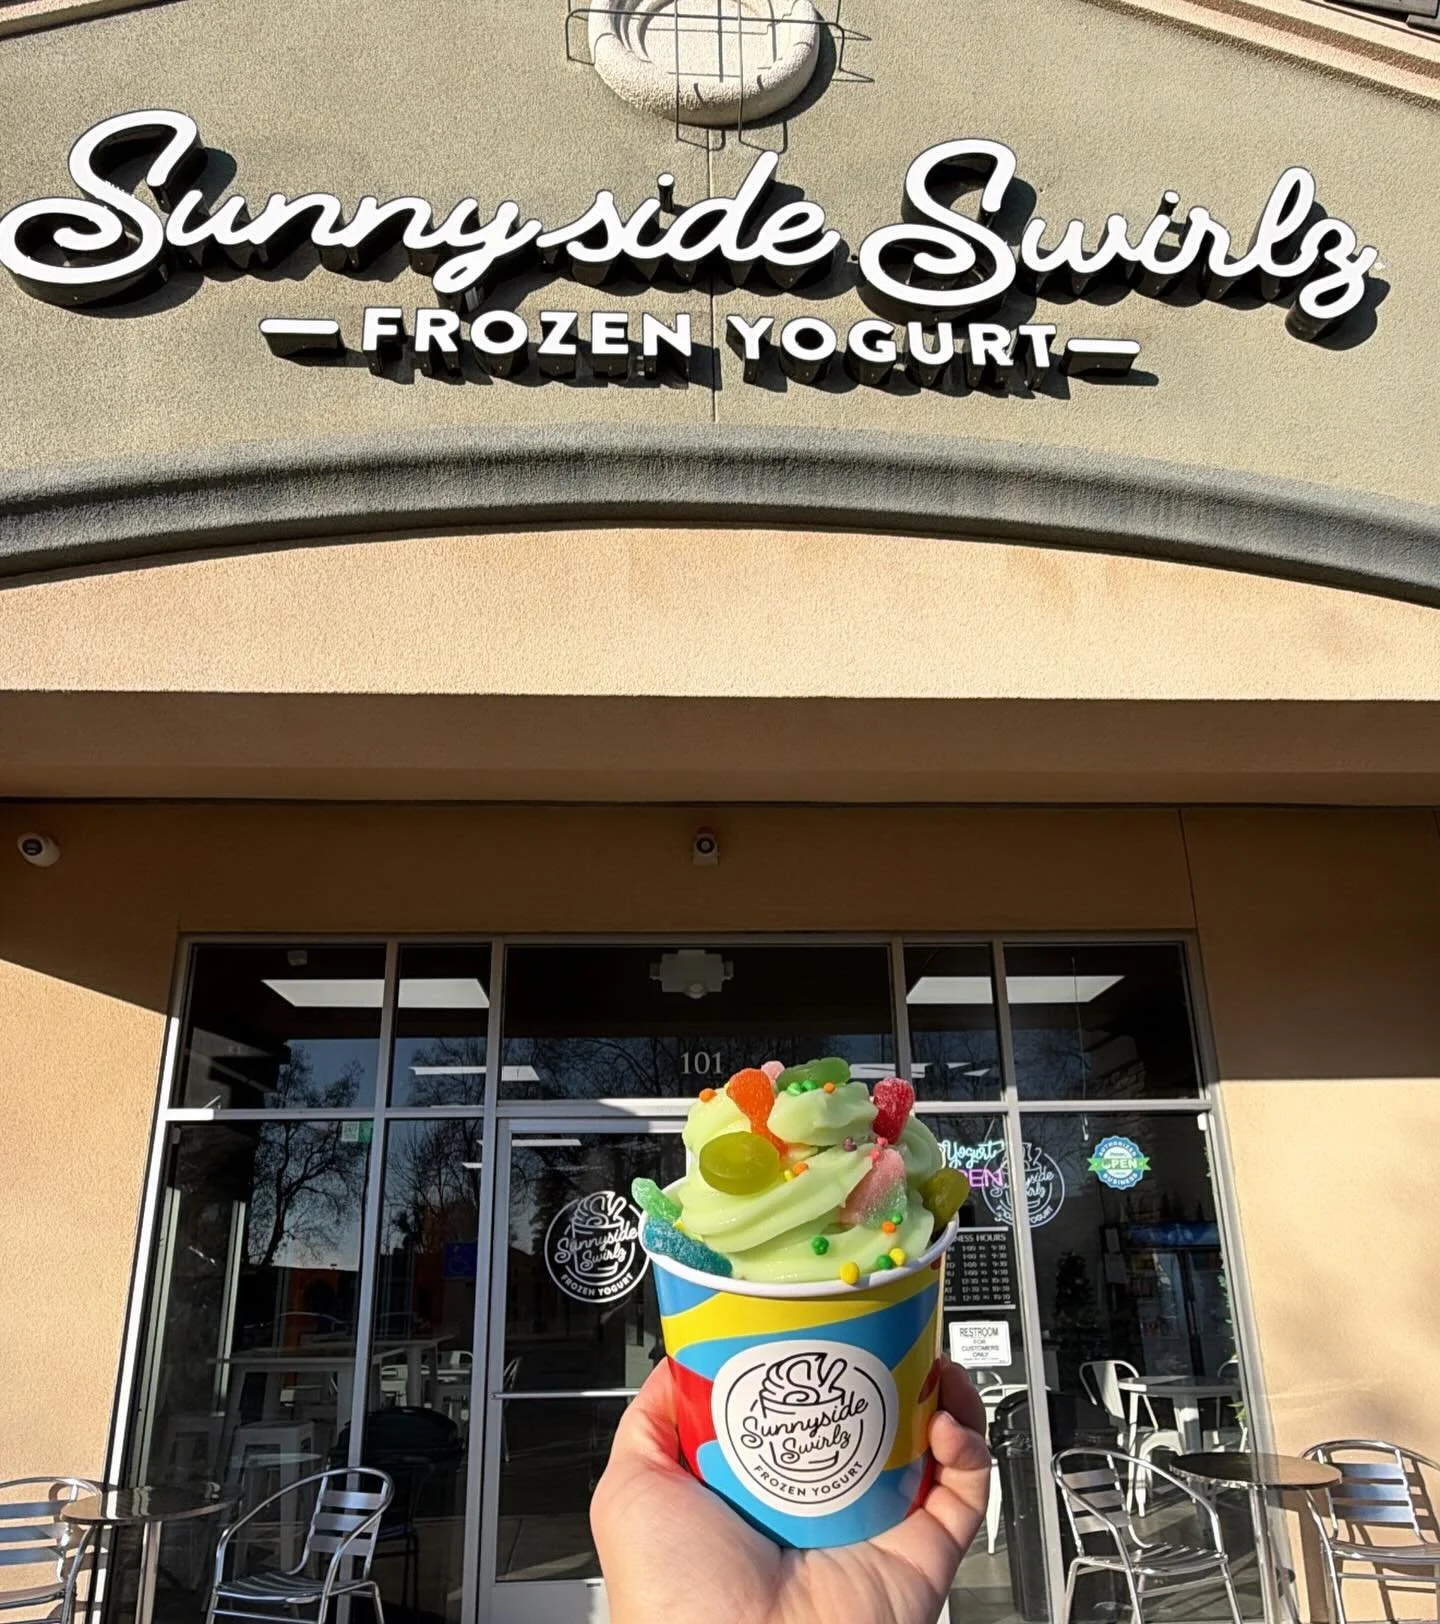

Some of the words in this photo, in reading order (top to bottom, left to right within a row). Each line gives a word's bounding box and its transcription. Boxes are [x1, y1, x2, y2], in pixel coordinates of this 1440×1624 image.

[0, 109, 841, 293] Sunnyside
[858, 137, 1379, 319] Swirlz
[361, 307, 692, 357] FROZEN
[727, 316, 1057, 368] YOGURT
[680, 1051, 723, 1075] 101
[960, 1168, 1005, 1188] EN
[1101, 1158, 1138, 1169] OPEN
[554, 1220, 638, 1264] Sunnyside
[579, 1241, 628, 1271] Swirlz
[560, 1274, 596, 1297] FROZEN
[597, 1271, 635, 1297] YOGURT
[959, 1327, 999, 1337] RESTROOM
[740, 1391, 869, 1449] Sunnyside
[780, 1423, 852, 1465] Swirlz
[753, 1464, 807, 1497] FROZEN
[811, 1460, 864, 1497] YOGURT
